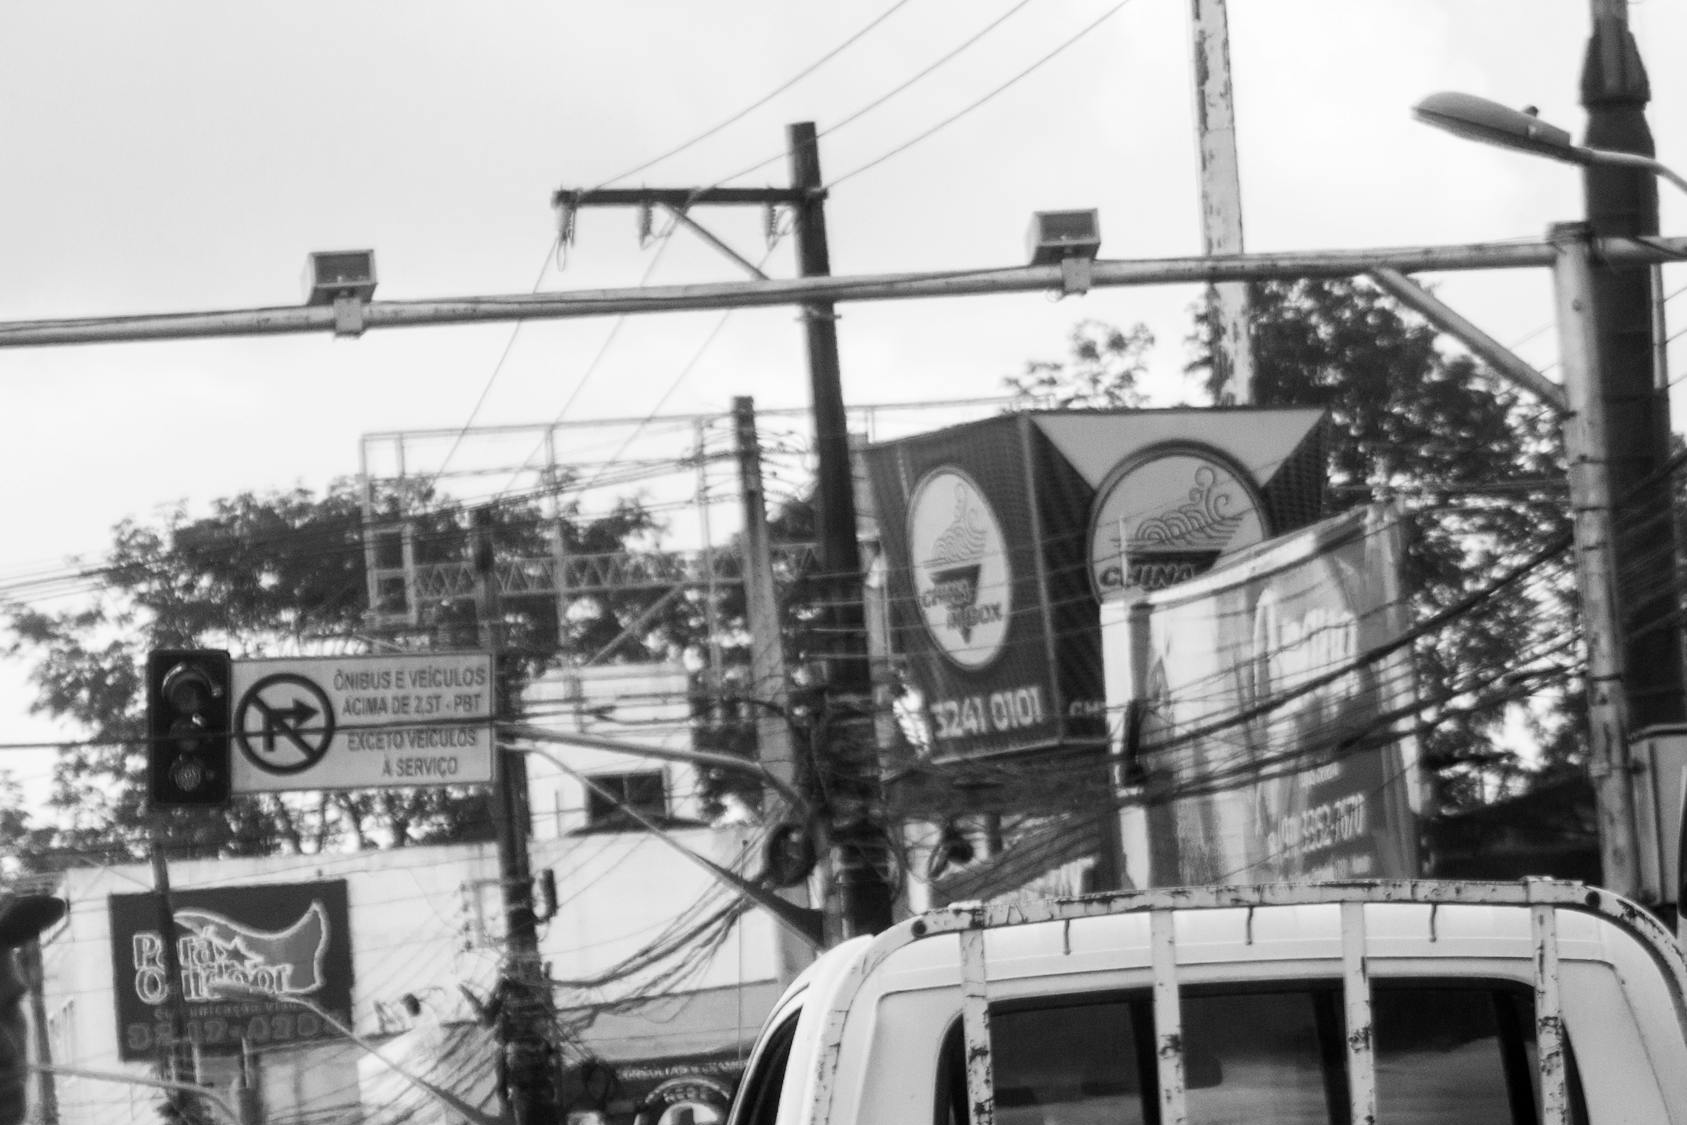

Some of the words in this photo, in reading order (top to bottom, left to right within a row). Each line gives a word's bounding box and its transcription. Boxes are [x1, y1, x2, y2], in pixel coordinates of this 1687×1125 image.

[333, 669, 391, 691] ÔNIBUS
[396, 670, 404, 689] E
[409, 665, 486, 689] VEÍCULOS
[342, 696, 388, 716] ACIMA
[392, 695, 410, 715] DE
[454, 693, 481, 713] PBT
[931, 697, 987, 738] 3241
[991, 687, 1043, 732] 0101
[347, 732, 404, 751] EXCETO
[396, 755, 459, 779] SERVIÇO
